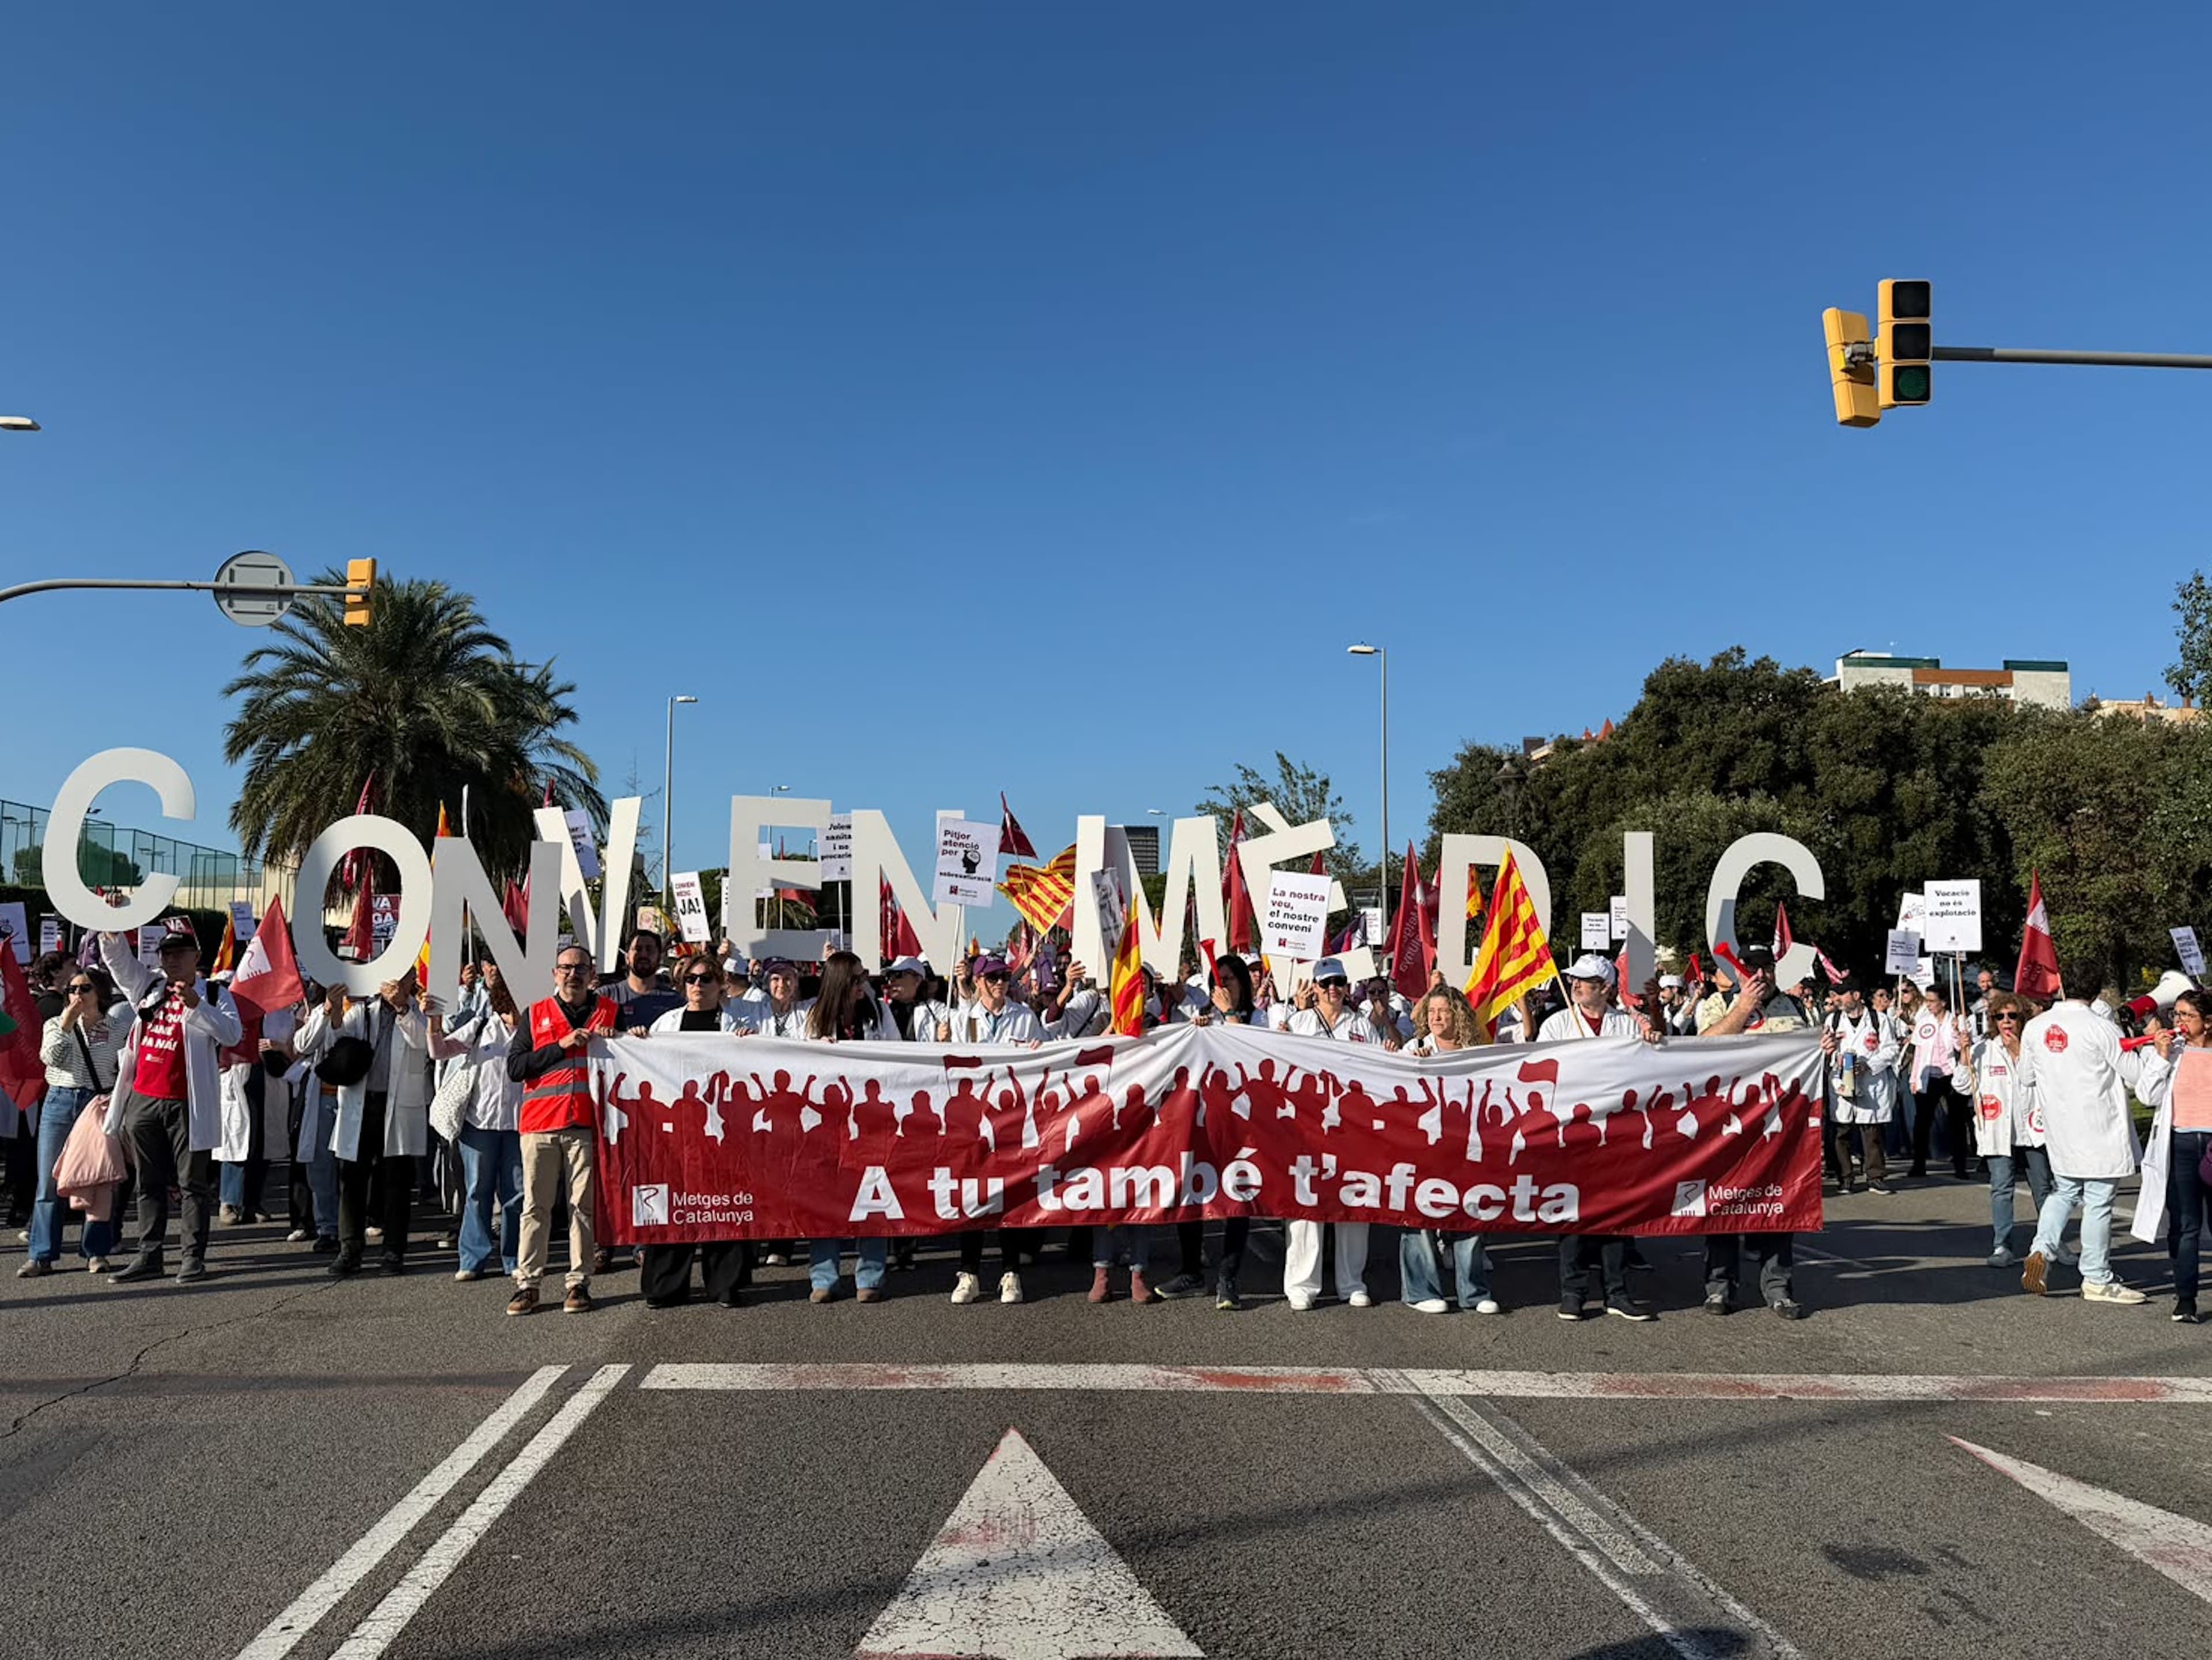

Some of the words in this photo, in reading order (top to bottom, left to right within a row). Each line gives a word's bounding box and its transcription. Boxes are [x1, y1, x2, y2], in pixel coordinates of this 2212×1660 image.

[944, 830, 971, 840] Pitjor
[942, 840, 979, 850] atenció
[1272, 888, 1286, 897] La
[1289, 891, 1325, 902] nostra
[680, 897, 701, 915] JA!
[1271, 900, 1294, 910] veu,
[1283, 912, 1319, 923] nostre
[1268, 922, 1312, 933] conveni
[848, 1165, 905, 1222] A
[927, 1166, 1004, 1219] tu
[1031, 1146, 1263, 1211] també
[1288, 1152, 1580, 1223] t'afecta
[1709, 1185, 1762, 1202] Metges
[1764, 1183, 1783, 1197] de
[672, 1191, 730, 1209] Metges
[733, 1191, 753, 1205] de
[1710, 1202, 1784, 1216] Catalunya
[672, 1209, 753, 1225] Catalunya
